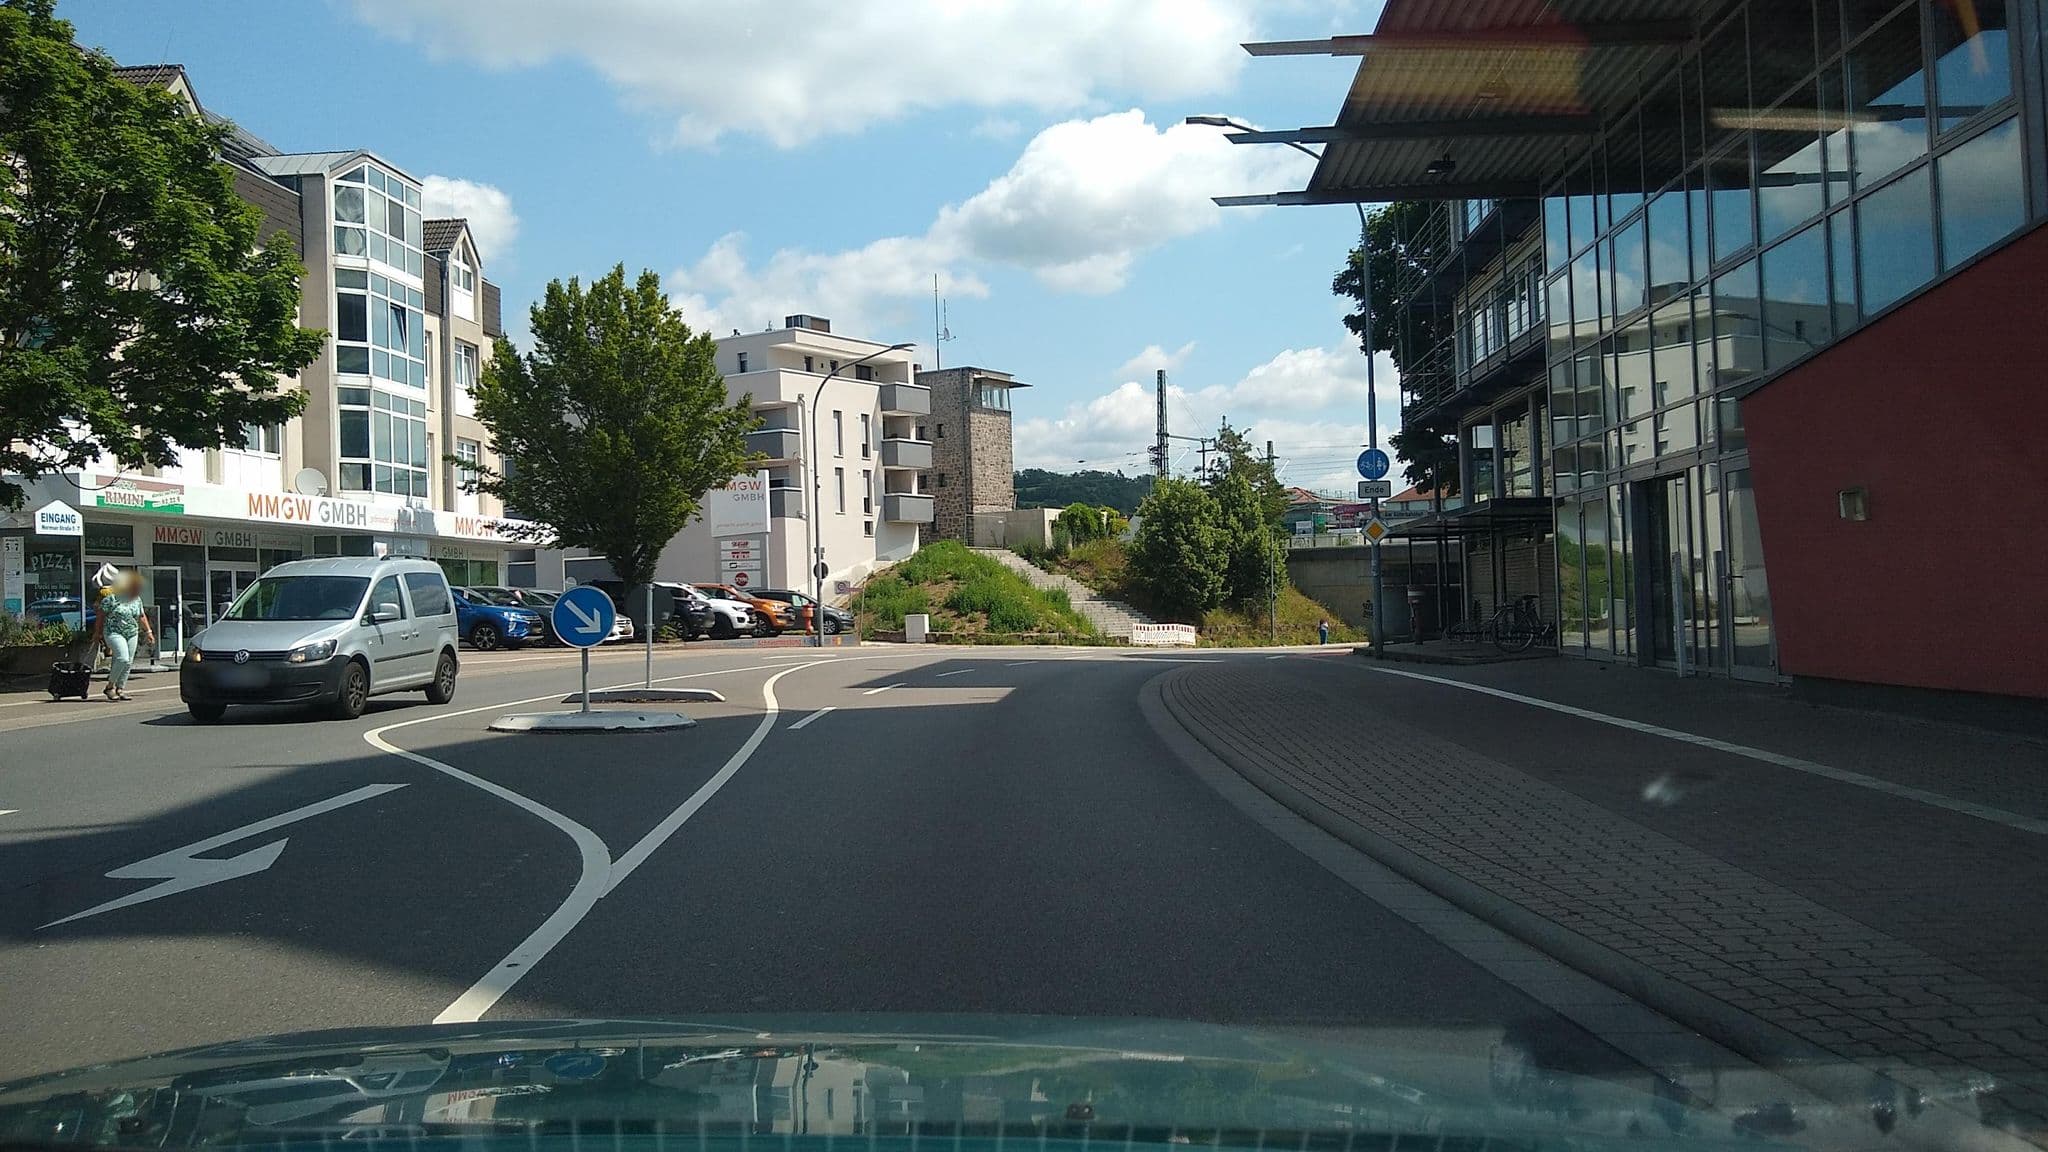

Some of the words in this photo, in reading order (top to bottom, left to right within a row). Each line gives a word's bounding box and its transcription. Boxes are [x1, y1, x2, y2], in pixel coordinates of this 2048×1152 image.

[1365, 485, 1384, 493] Ende
[105, 491, 145, 506] RIMINI
[734, 493, 765, 502] GMBH
[248, 493, 312, 521] MMGW
[318, 500, 367, 527] GMBH
[41, 512, 76, 524] EINGANG
[155, 526, 202, 544] MMGW
[215, 531, 252, 547] GMBH
[442, 547, 463, 558] GMBH
[31, 553, 73, 573] PIZZA
